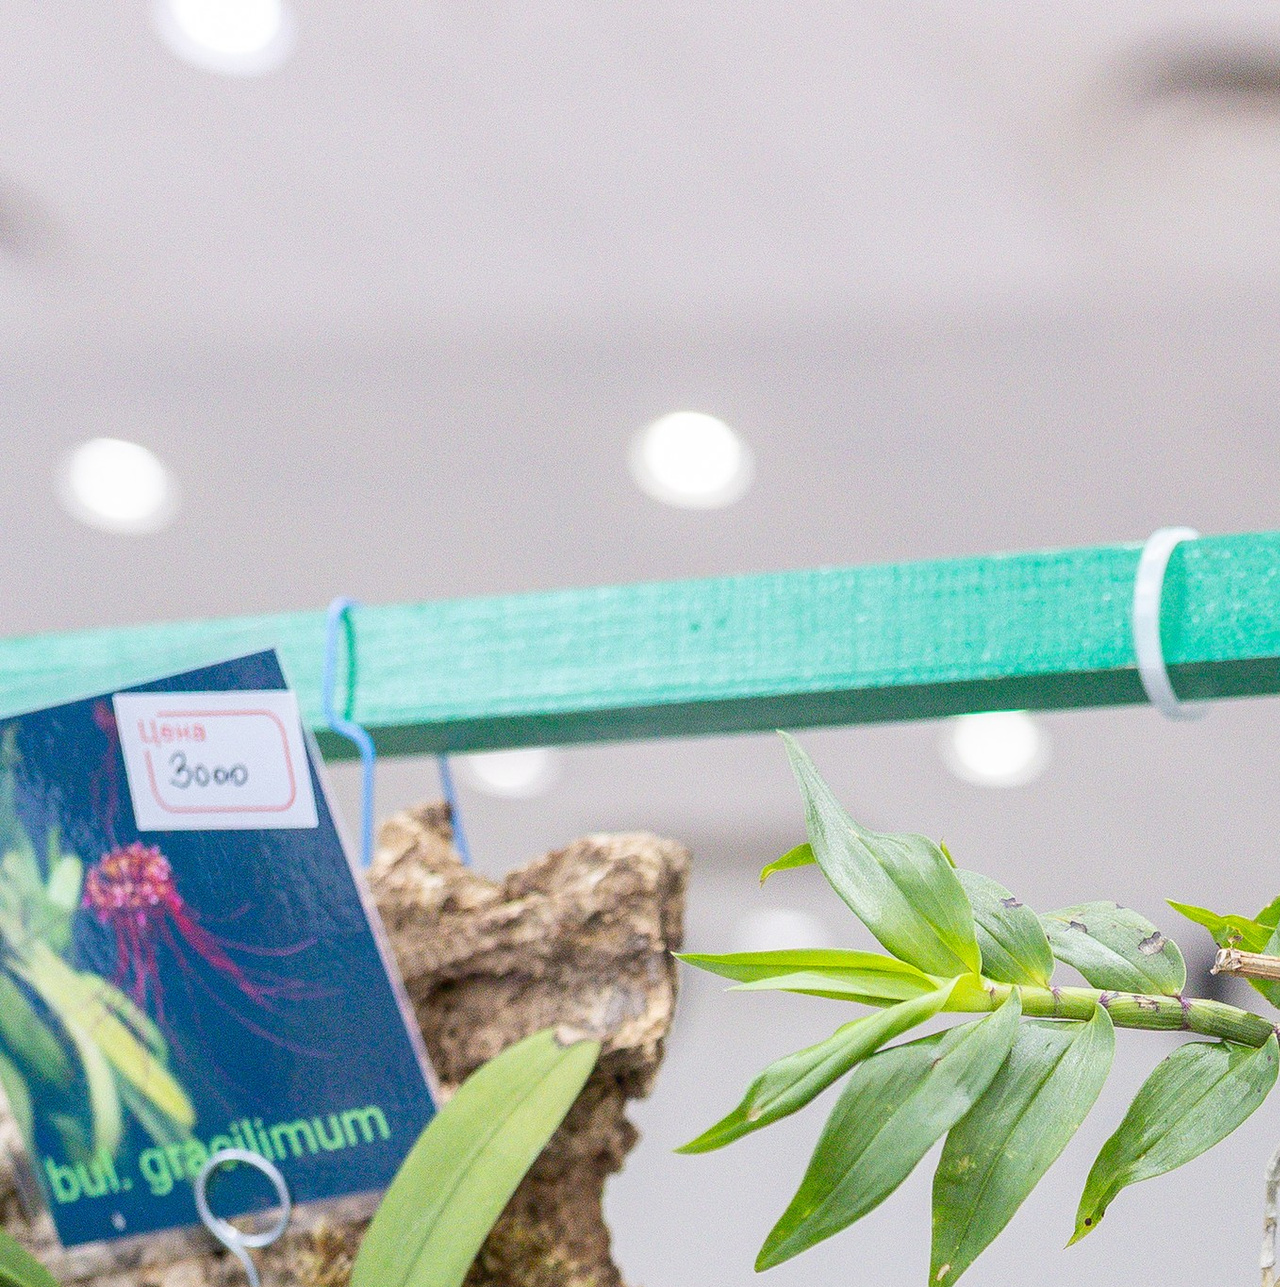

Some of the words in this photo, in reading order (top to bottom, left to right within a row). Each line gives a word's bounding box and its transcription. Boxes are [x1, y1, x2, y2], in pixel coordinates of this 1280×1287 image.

[137, 718, 206, 747] Цена
[168, 749, 249, 790] 3000
[45, 1152, 133, 1204] bul.
